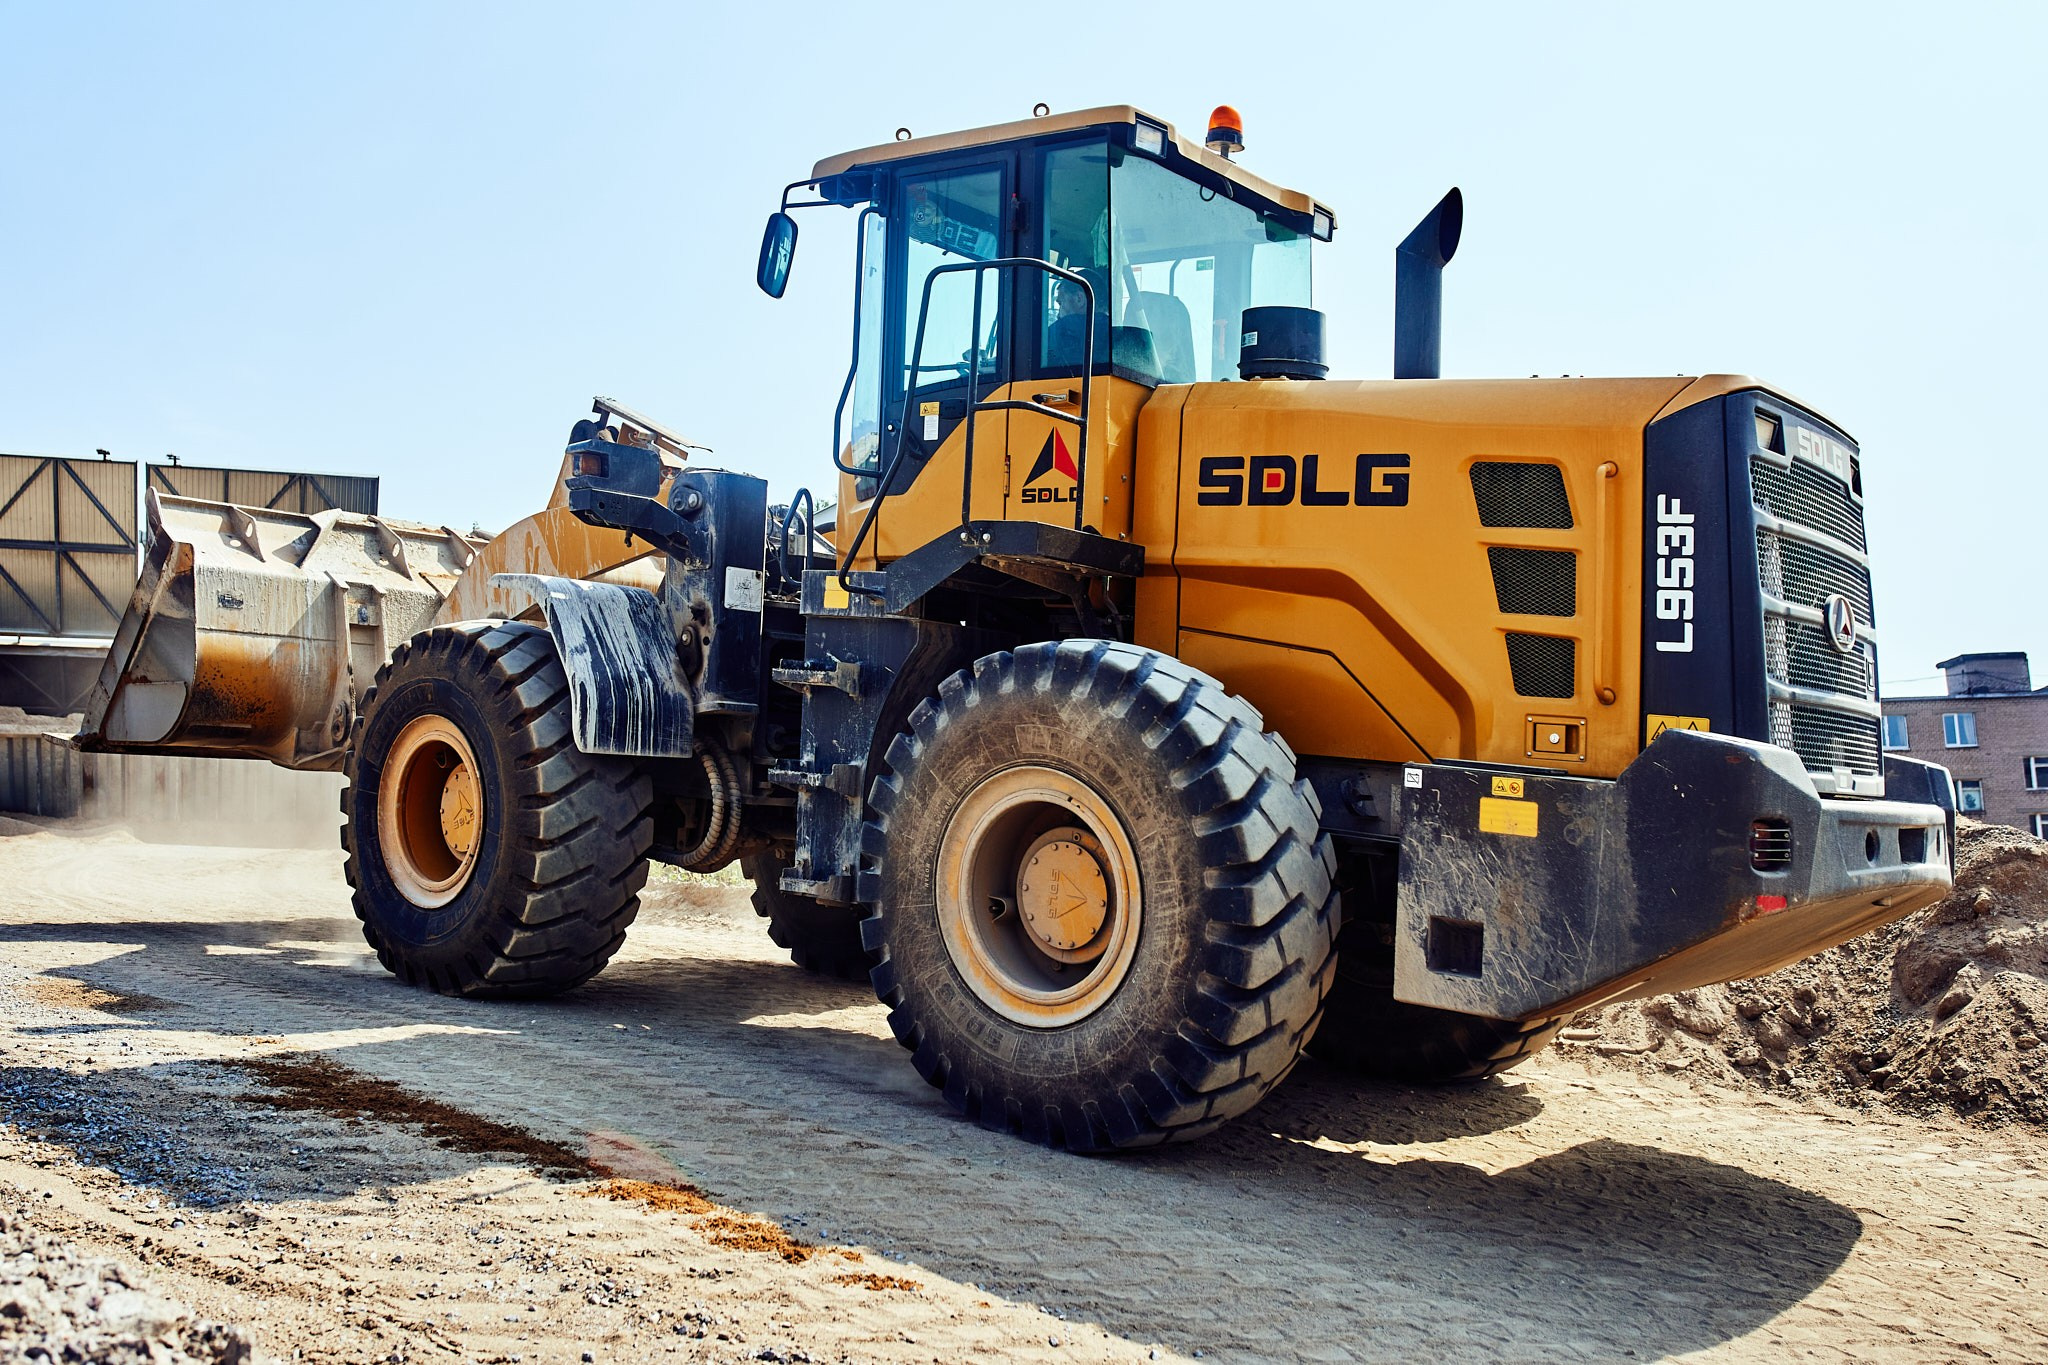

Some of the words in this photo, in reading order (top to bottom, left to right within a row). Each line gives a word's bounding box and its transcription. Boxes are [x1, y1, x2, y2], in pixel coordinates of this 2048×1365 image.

[1798, 426, 1845, 479] SDLG
[1197, 453, 1411, 507] SDLG
[1656, 494, 1695, 653] L953F
[1046, 868, 1060, 920] SDLG
